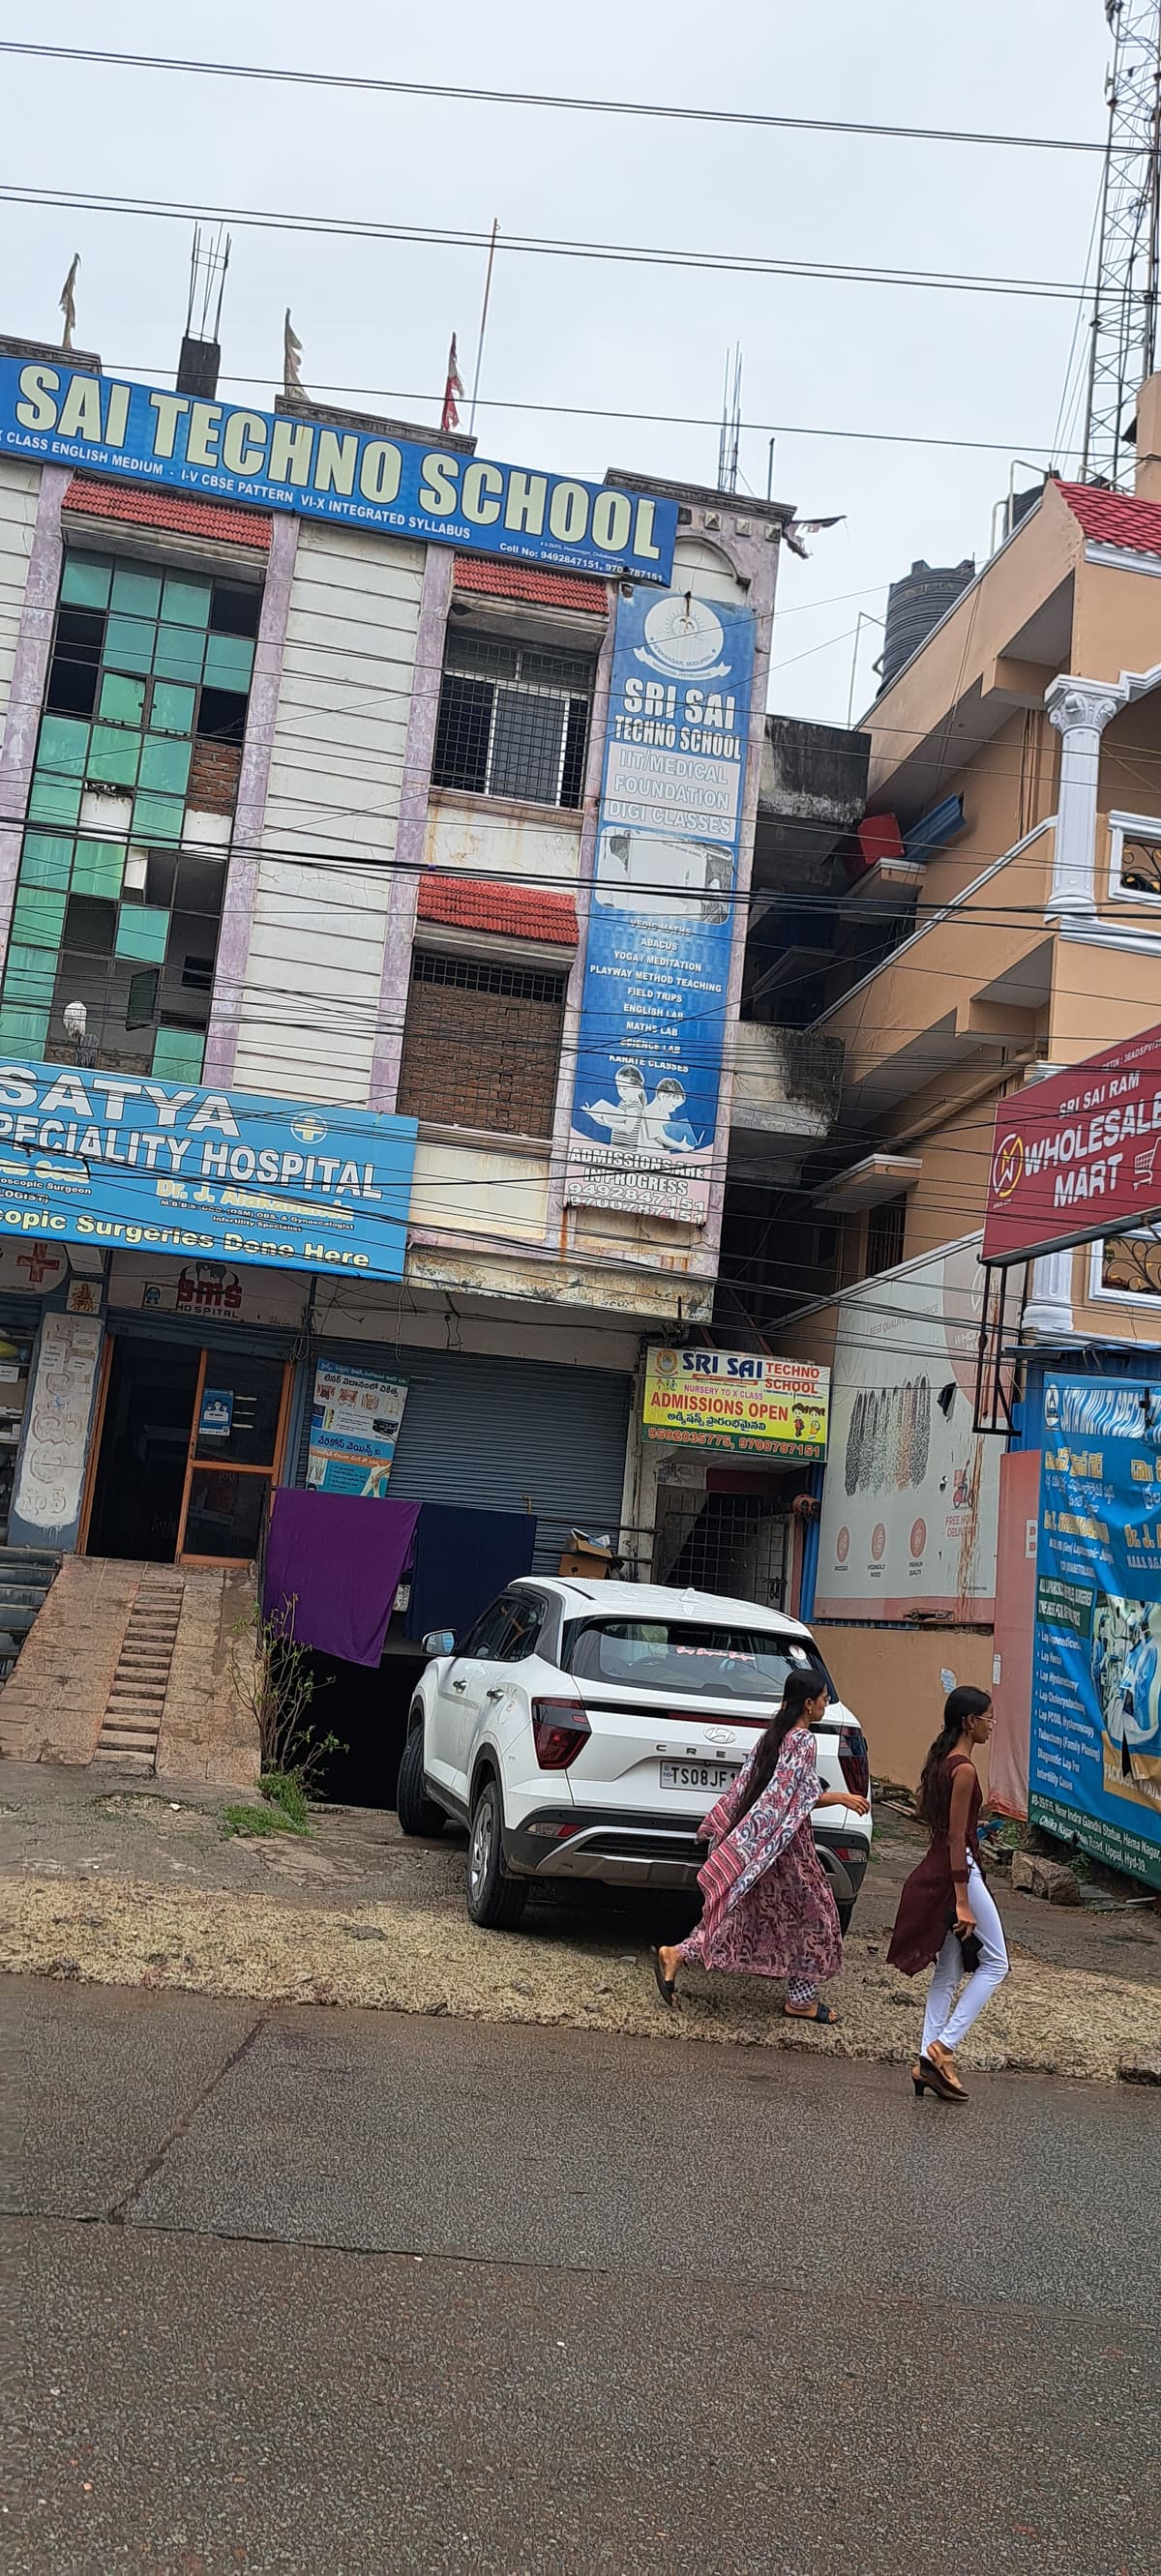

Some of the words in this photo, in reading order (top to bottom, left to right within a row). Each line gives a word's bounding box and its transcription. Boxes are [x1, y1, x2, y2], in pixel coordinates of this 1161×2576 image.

[15, 364, 132, 448] SAI
[150, 391, 402, 504] TECHNO
[418, 453, 662, 559] SCHOOL
[7, 432, 47, 450] CLASS
[51, 441, 108, 463] ENGLISH
[111, 455, 164, 475] MEDIUM
[181, 468, 198, 482] I-V
[201, 473, 235, 490] CBSE
[237, 482, 293, 503] PATTERN
[301, 493, 325, 510] VI-X
[328, 499, 406, 526] INTEGRATED
[408, 516, 471, 540] SYLLABUS
[499, 542, 520, 554] Cell
[521, 547, 538, 558] No:
[540, 550, 603, 571] 9492847151,
[605, 563, 663, 582] 970787151
[623, 678, 677, 720] SRI
[685, 688, 736, 730] SAI
[614, 715, 675, 750] TECHNO
[679, 726, 742, 760] SCHOOL
[619, 749, 729, 785] IIT/MEDICAL
[613, 775, 729, 810] FOUNDATION
[608, 800, 646, 822] DIGI
[651, 806, 731, 836] CLASSES
[640, 938, 678, 951] ABACUS
[613, 950, 639, 962] YOGA
[646, 956, 702, 972] MEDITATION
[590, 964, 634, 978] PLAYWAY
[636, 971, 673, 985] METHOD
[676, 977, 722, 993] TEACHING
[628, 988, 653, 998] FIELD
[657, 991, 683, 1003] TRIPS
[623, 1003, 664, 1017] ENGLISH
[666, 1009, 684, 1021] LAB
[626, 1021, 658, 1033] MATHS
[660, 1026, 678, 1037] LAB
[620, 1038, 660, 1051] SCIENCE
[663, 1045, 681, 1054] LAB
[609, 1054, 646, 1067] KARATE
[648, 1059, 689, 1074] CLASSES
[0, 1066, 241, 1139] SATYA
[1058, 1099, 1079, 1119] SRI
[1083, 1083, 1105, 1110] SAI
[1109, 1071, 1141, 1099] RAM
[1025, 1090, 1161, 1177] WHOLESALE
[200, 1140, 383, 1200] HOSPITAL
[569, 1147, 671, 1173] ADMISSIONS
[673, 1161, 705, 1178] ARE
[46, 1182, 92, 1195] Surgeon
[156, 1179, 188, 1199] Dr.
[194, 1180, 215, 1203] J.
[584, 1168, 604, 1182] IN
[605, 1170, 688, 1196] PROGRESS
[1053, 1153, 1123, 1208] MART
[568, 1182, 705, 1212] 9492847151
[212, 1215, 254, 1228] Infertility
[257, 1221, 302, 1232] Specialist
[76, 1214, 215, 1249] Surgeries
[223, 1232, 295, 1257] Done
[303, 1242, 371, 1267] Here
[177, 1304, 240, 1318] HOSPITAL
[682, 1352, 718, 1375] SRI
[727, 1358, 762, 1378] SAI
[765, 1362, 819, 1379] TECHNO
[684, 1384, 720, 1396] NURSERY
[721, 1388, 730, 1397] TO
[739, 1390, 763, 1401] CLASS
[764, 1377, 819, 1394] SCHOOL
[650, 1391, 744, 1416] ADMISSIONS
[748, 1402, 789, 1422] OPEN
[739, 1437, 820, 1458] 9700787151
[1082, 1815, 1102, 1836] Gandhi
[1102, 1823, 1122, 1846] Statue,
[1123, 1832, 1141, 1851] Hema
[1141, 1840, 1161, 1862] Nagar,
